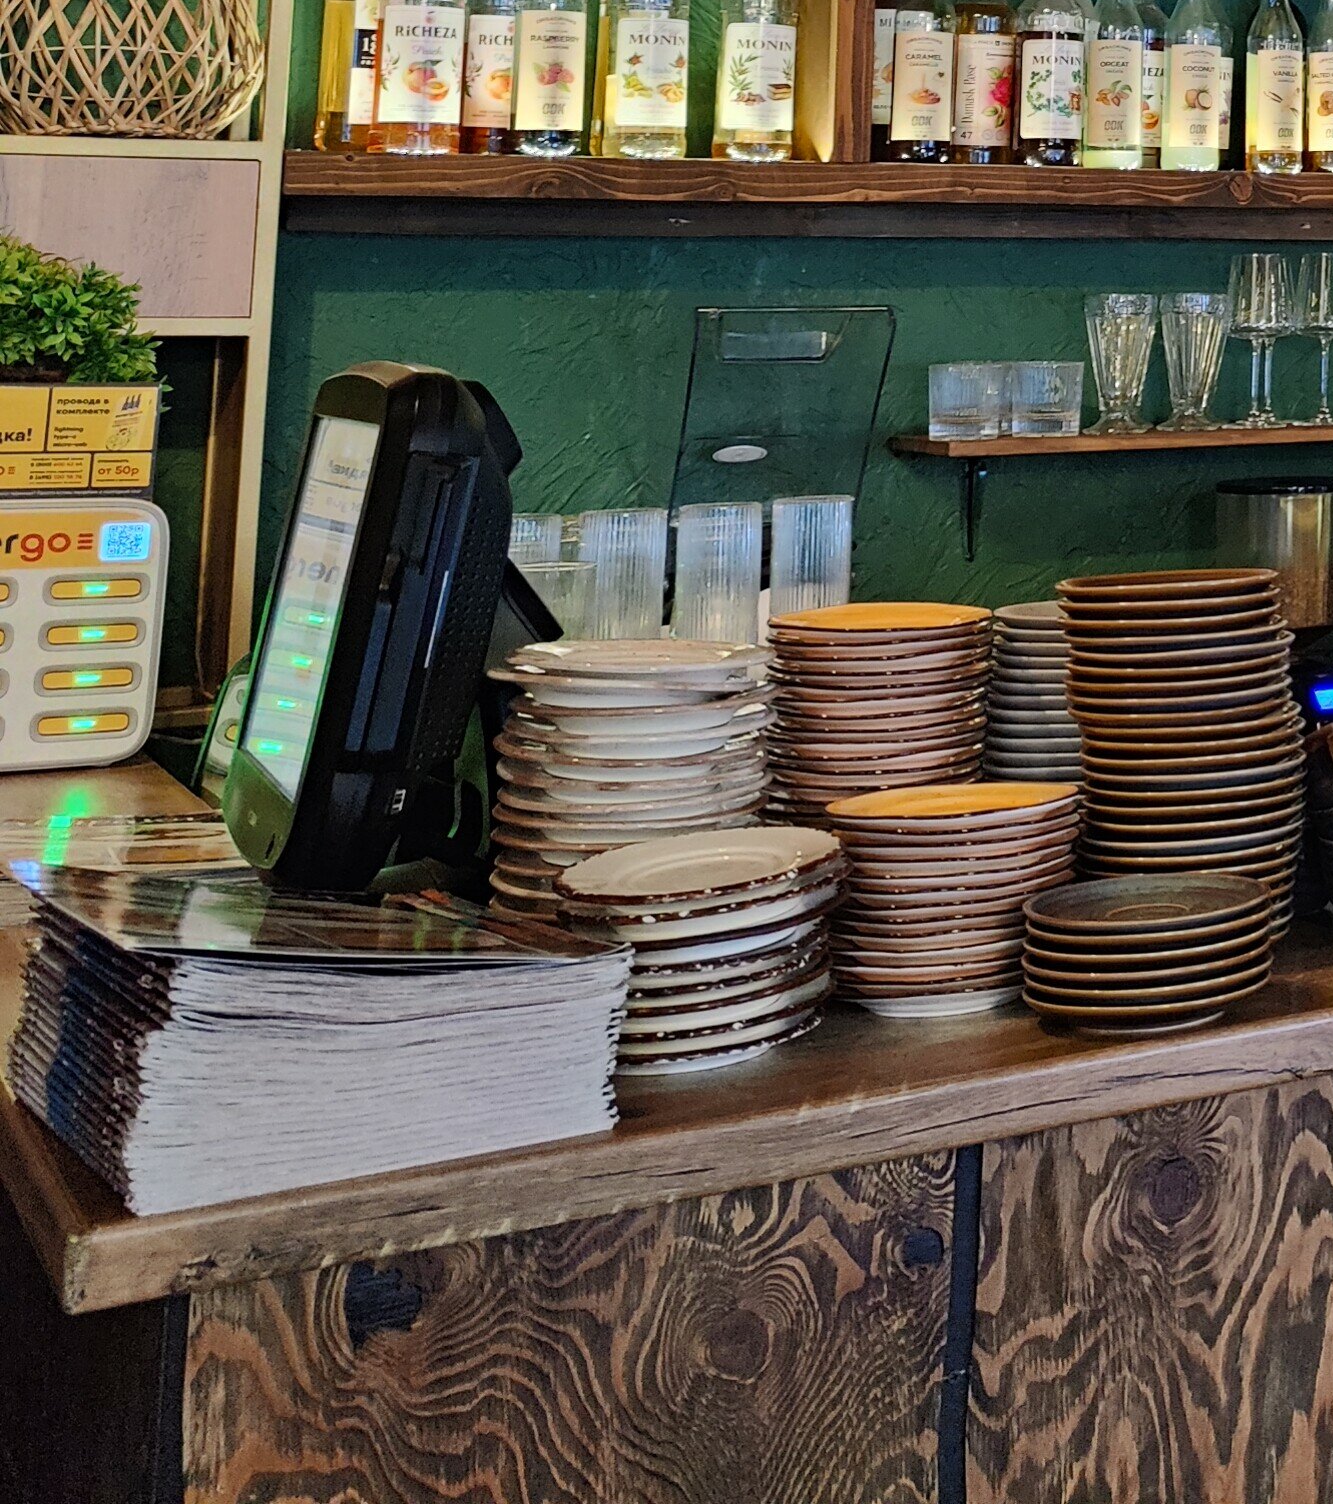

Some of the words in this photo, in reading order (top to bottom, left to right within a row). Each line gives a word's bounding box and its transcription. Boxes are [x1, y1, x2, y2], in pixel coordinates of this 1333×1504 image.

[478, 33, 513, 46] RiCH
[530, 34, 579, 43] RASPBERRY
[629, 33, 686, 46] MONIN
[736, 39, 793, 52] MONIN
[905, 53, 943, 61] CARAMEL
[1032, 55, 1082, 66] MONIN
[1182, 65, 1215, 73] COCONUT
[1273, 70, 1298, 78] VANILLA
[960, 131, 973, 140] 47
[0, 428, 33, 444] ка!
[98, 467, 112, 475] от
[115, 465, 140, 476] 50р
[0, 532, 72, 562] rgo
